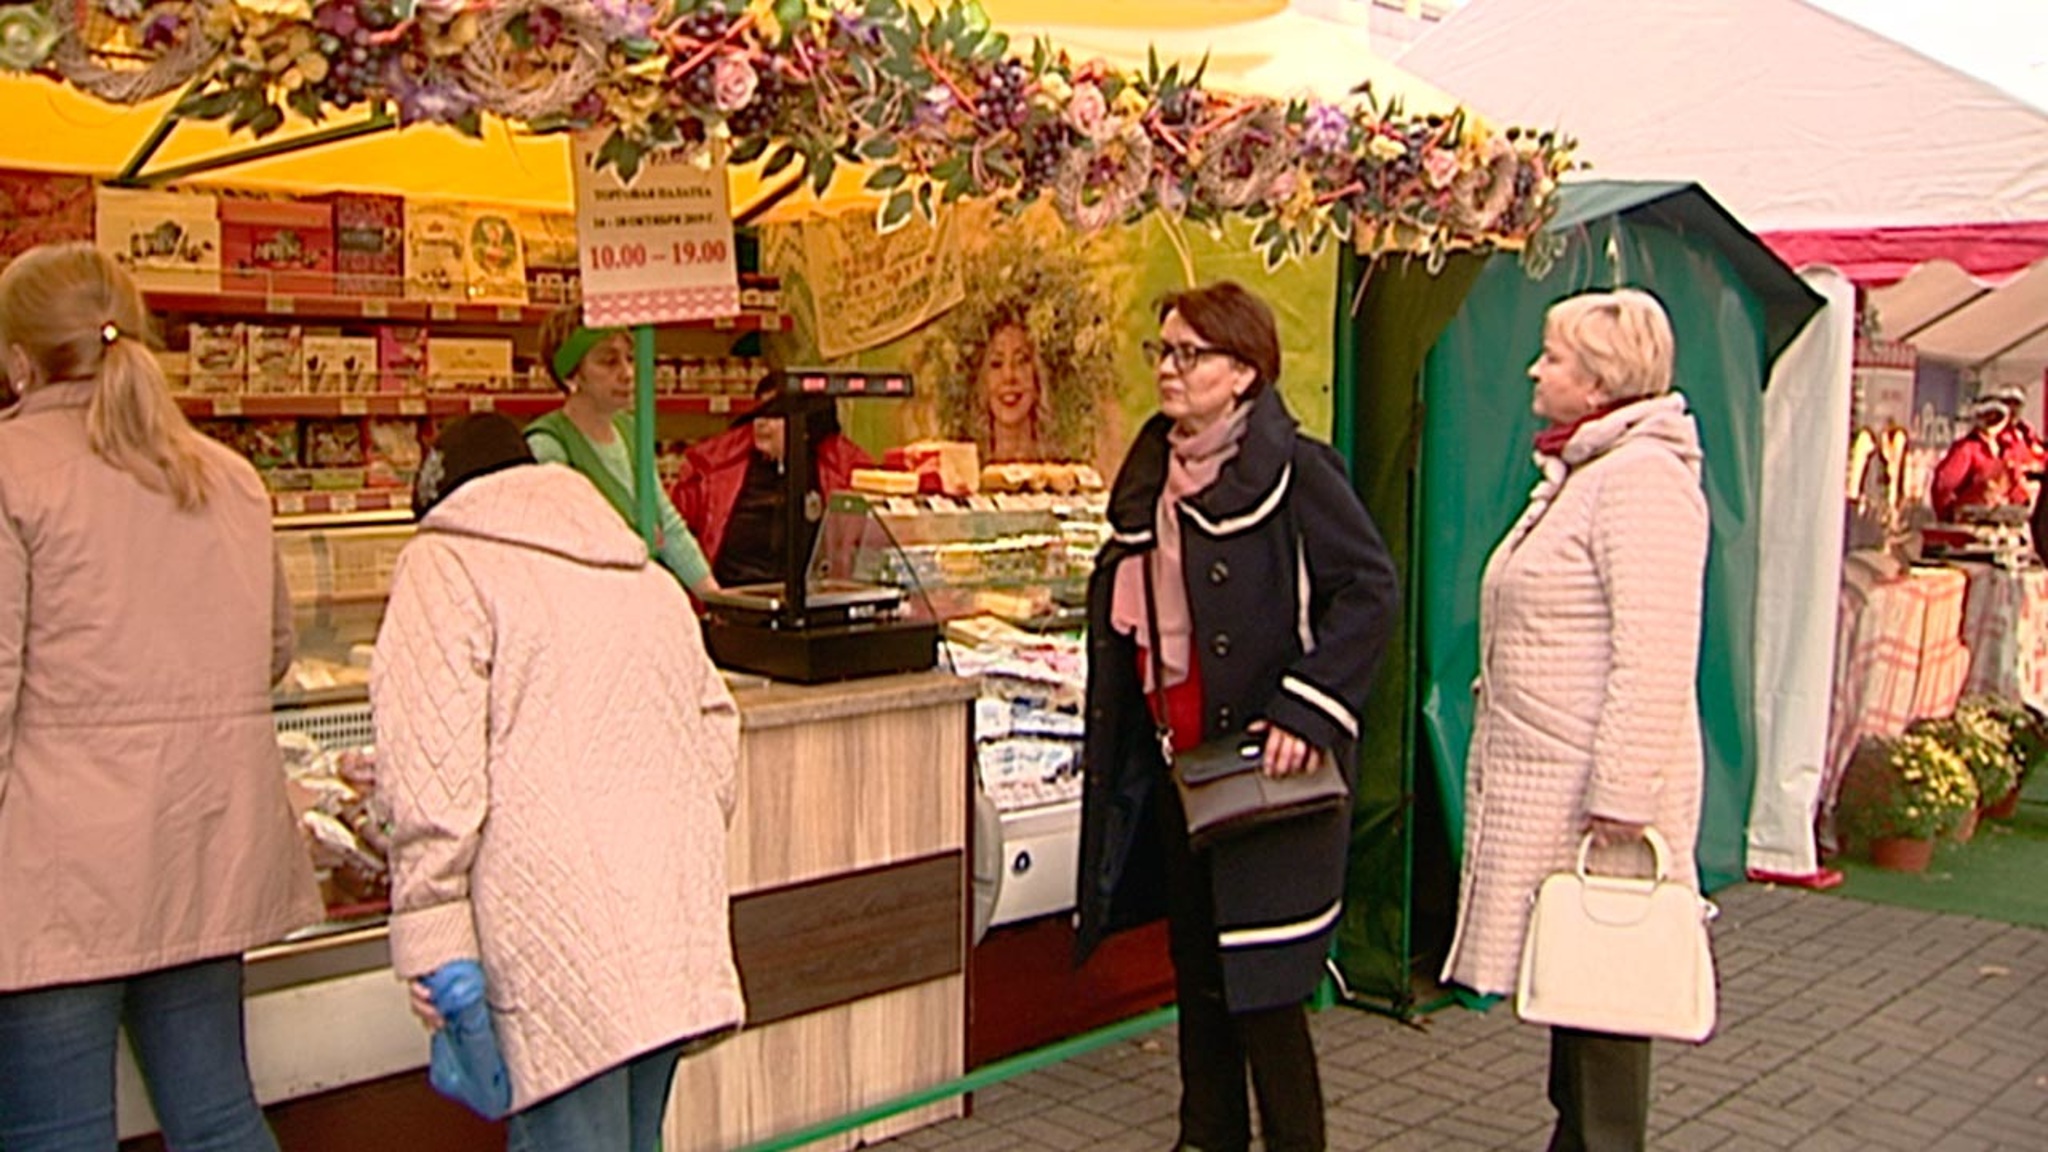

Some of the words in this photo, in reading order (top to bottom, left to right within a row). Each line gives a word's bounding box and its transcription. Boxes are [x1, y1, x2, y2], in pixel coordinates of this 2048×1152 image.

[658, 187, 712, 199] ПАЛАТКА
[590, 243, 646, 270] 10.00
[672, 239, 727, 265] 19.00
